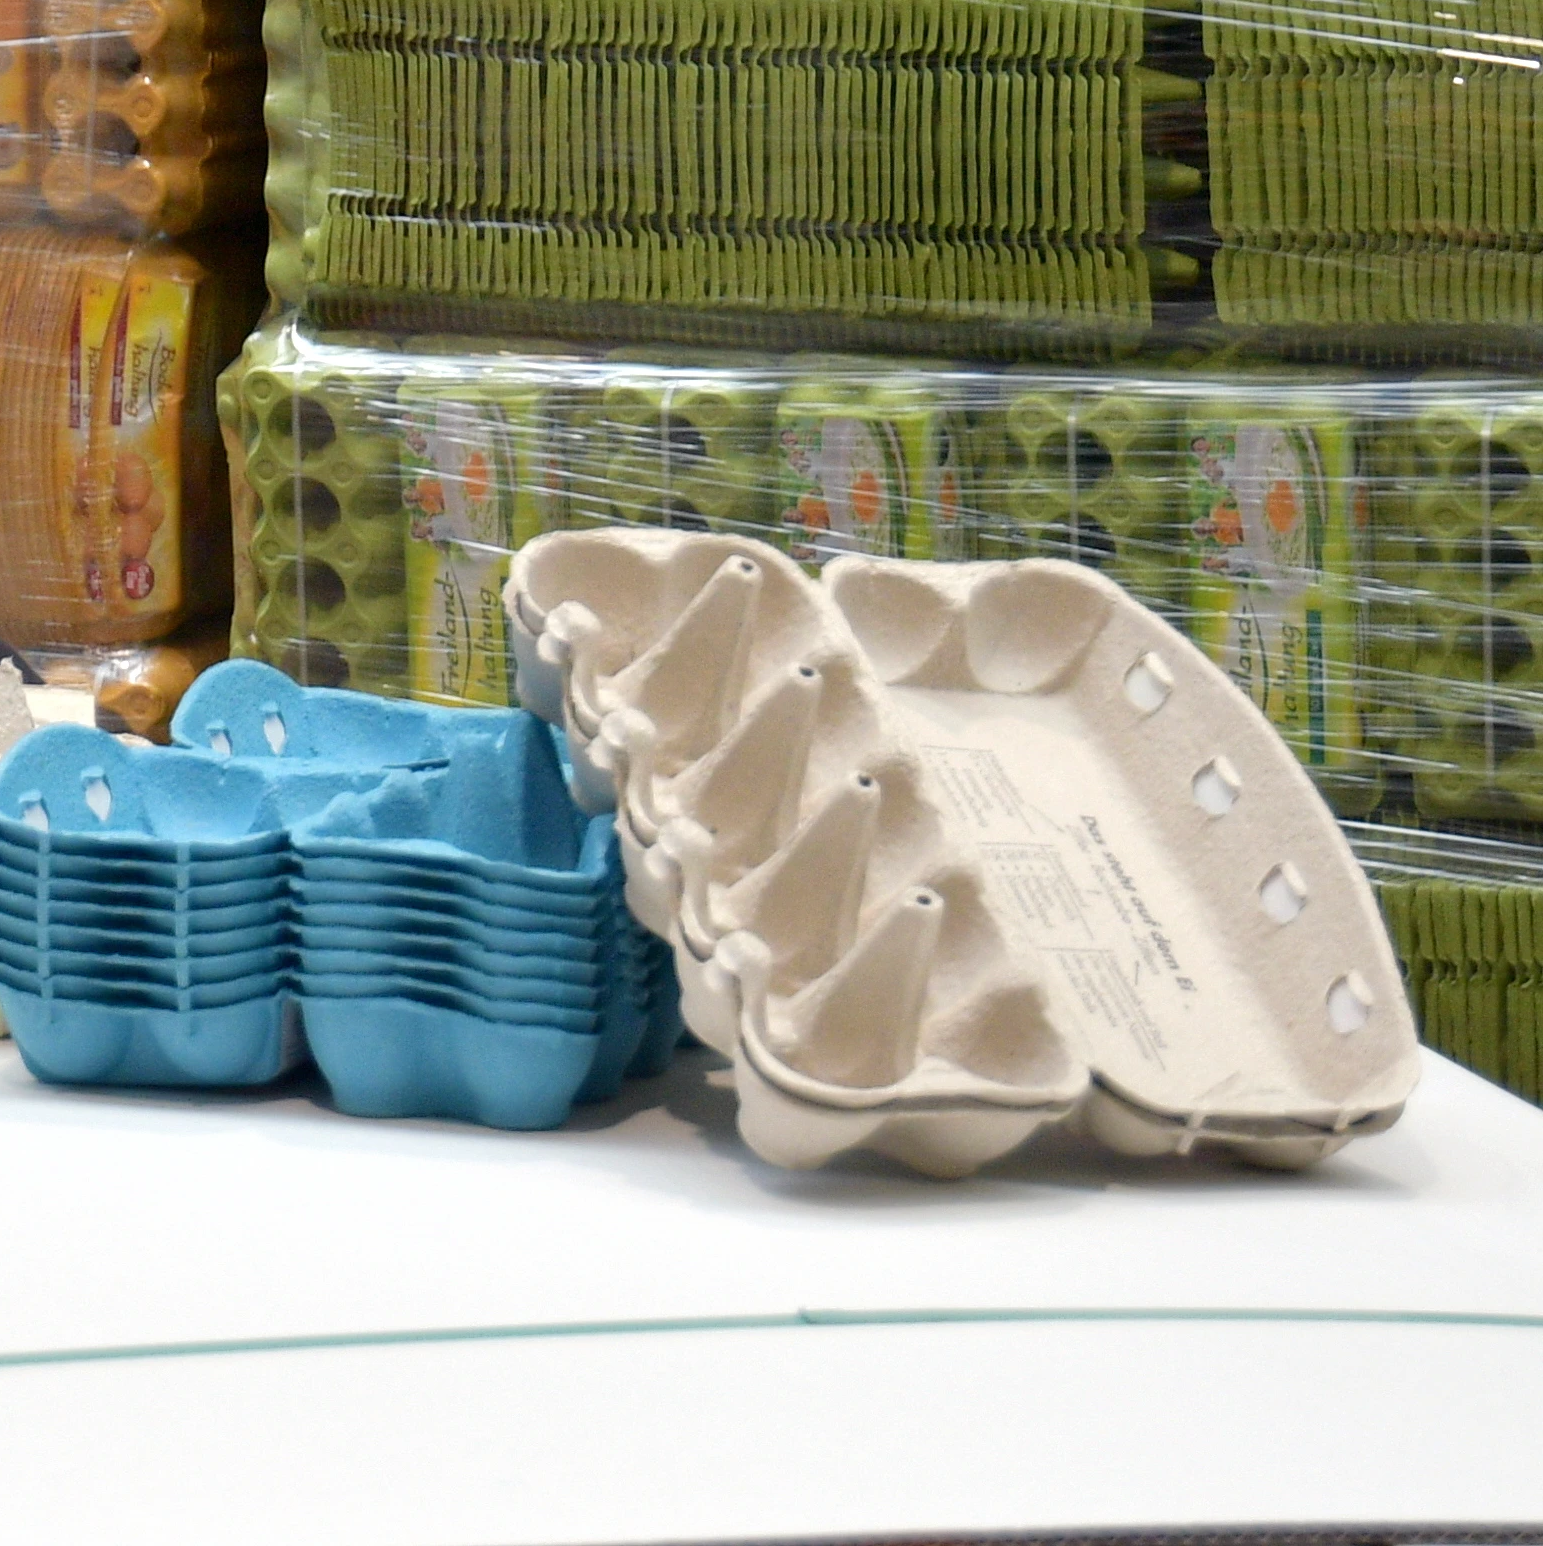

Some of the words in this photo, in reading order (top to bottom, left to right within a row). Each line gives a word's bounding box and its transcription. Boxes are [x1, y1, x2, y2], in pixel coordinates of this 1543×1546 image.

[435, 571, 460, 695] Freiland-
[1080, 815, 1105, 845] Das
[1102, 851, 1137, 892] steht
[1131, 896, 1162, 928] auf
[1151, 931, 1180, 970] dem
[1175, 976, 1197, 992] Ei
